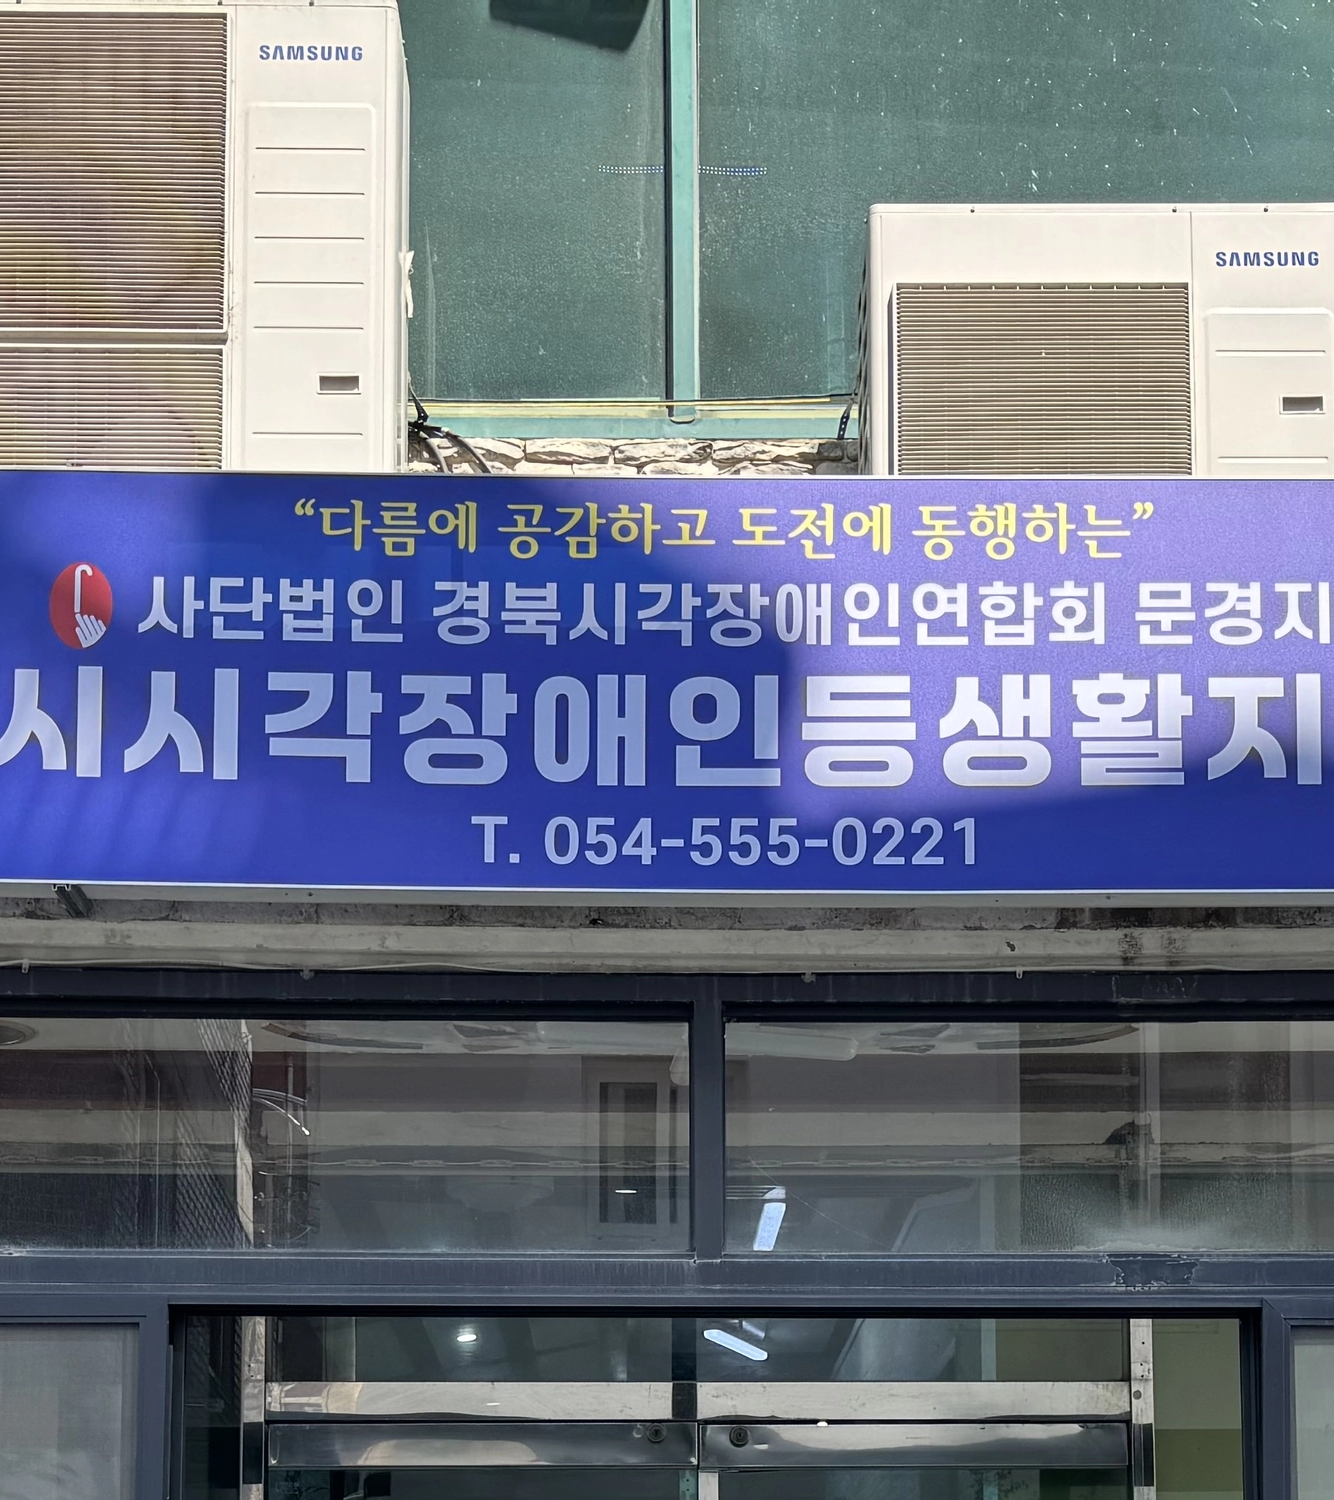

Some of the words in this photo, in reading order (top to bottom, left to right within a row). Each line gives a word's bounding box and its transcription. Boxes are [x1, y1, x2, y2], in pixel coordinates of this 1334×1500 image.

[259, 44, 364, 61] SAMSUNG
[1215, 251, 1320, 267] SAMSUNG
[294, 499, 478, 557] “다름에
[500, 501, 714, 560] 공감하고
[734, 502, 893, 560] 도전에
[914, 501, 1155, 561] 동행하는”
[136, 576, 405, 645] 사단법인
[431, 579, 1107, 648] 경북시각장애인연합회
[469, 814, 521, 865] T.
[543, 814, 976, 867] 054-555-0221
